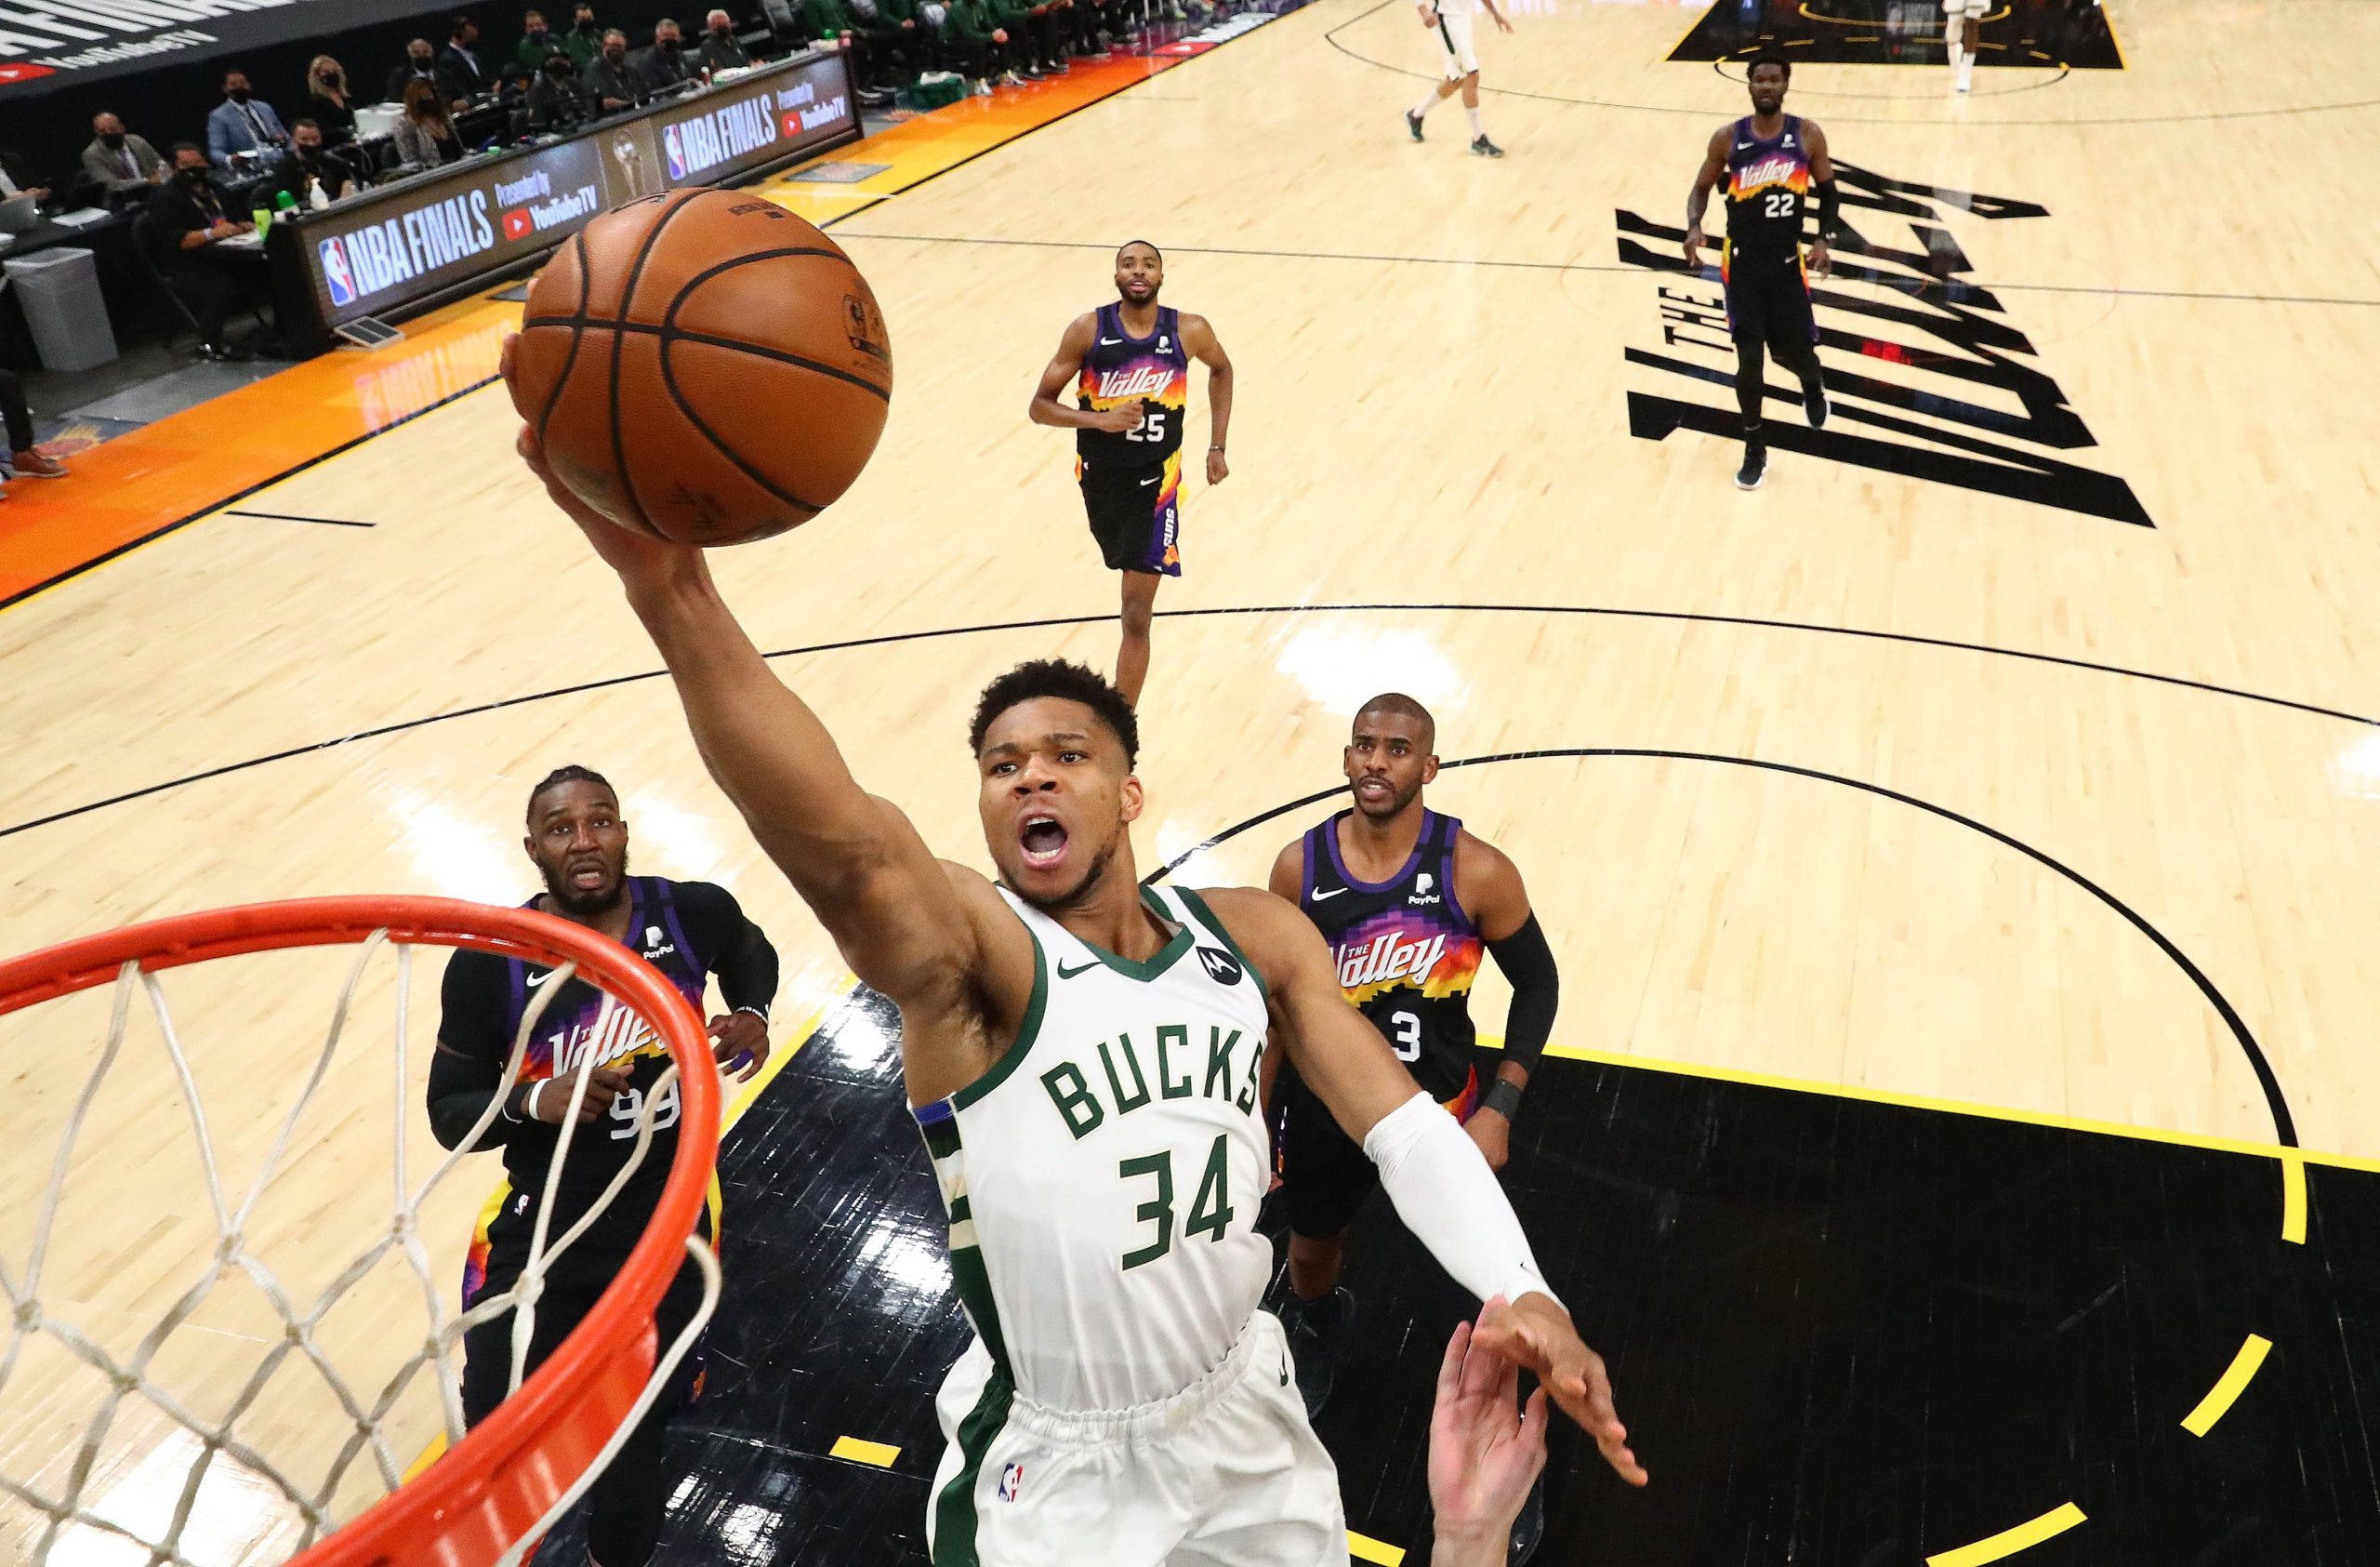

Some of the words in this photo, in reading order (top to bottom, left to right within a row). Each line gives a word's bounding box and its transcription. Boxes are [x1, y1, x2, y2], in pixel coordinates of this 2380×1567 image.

[679, 113, 723, 174] NBA
[716, 94, 777, 160] FINALS
[495, 171, 536, 208] Presented
[1739, 158, 1796, 190] Valley
[1765, 193, 1795, 219] 22
[345, 218, 415, 297] NBA
[402, 189, 495, 276] FINALS
[1658, 286, 1734, 352] THE
[1098, 365, 1175, 399] Valley
[1126, 413, 1166, 443] 25
[1408, 895, 1440, 906] PayPal
[642, 943, 675, 961] PayPal
[1348, 943, 1371, 957] THE
[548, 1003, 666, 1079] Valle
[1391, 1010, 1421, 1062] 3
[1039, 1024, 1263, 1140] BUCKS
[609, 1079, 681, 1140] 99
[1118, 1132, 1235, 1271] 34
